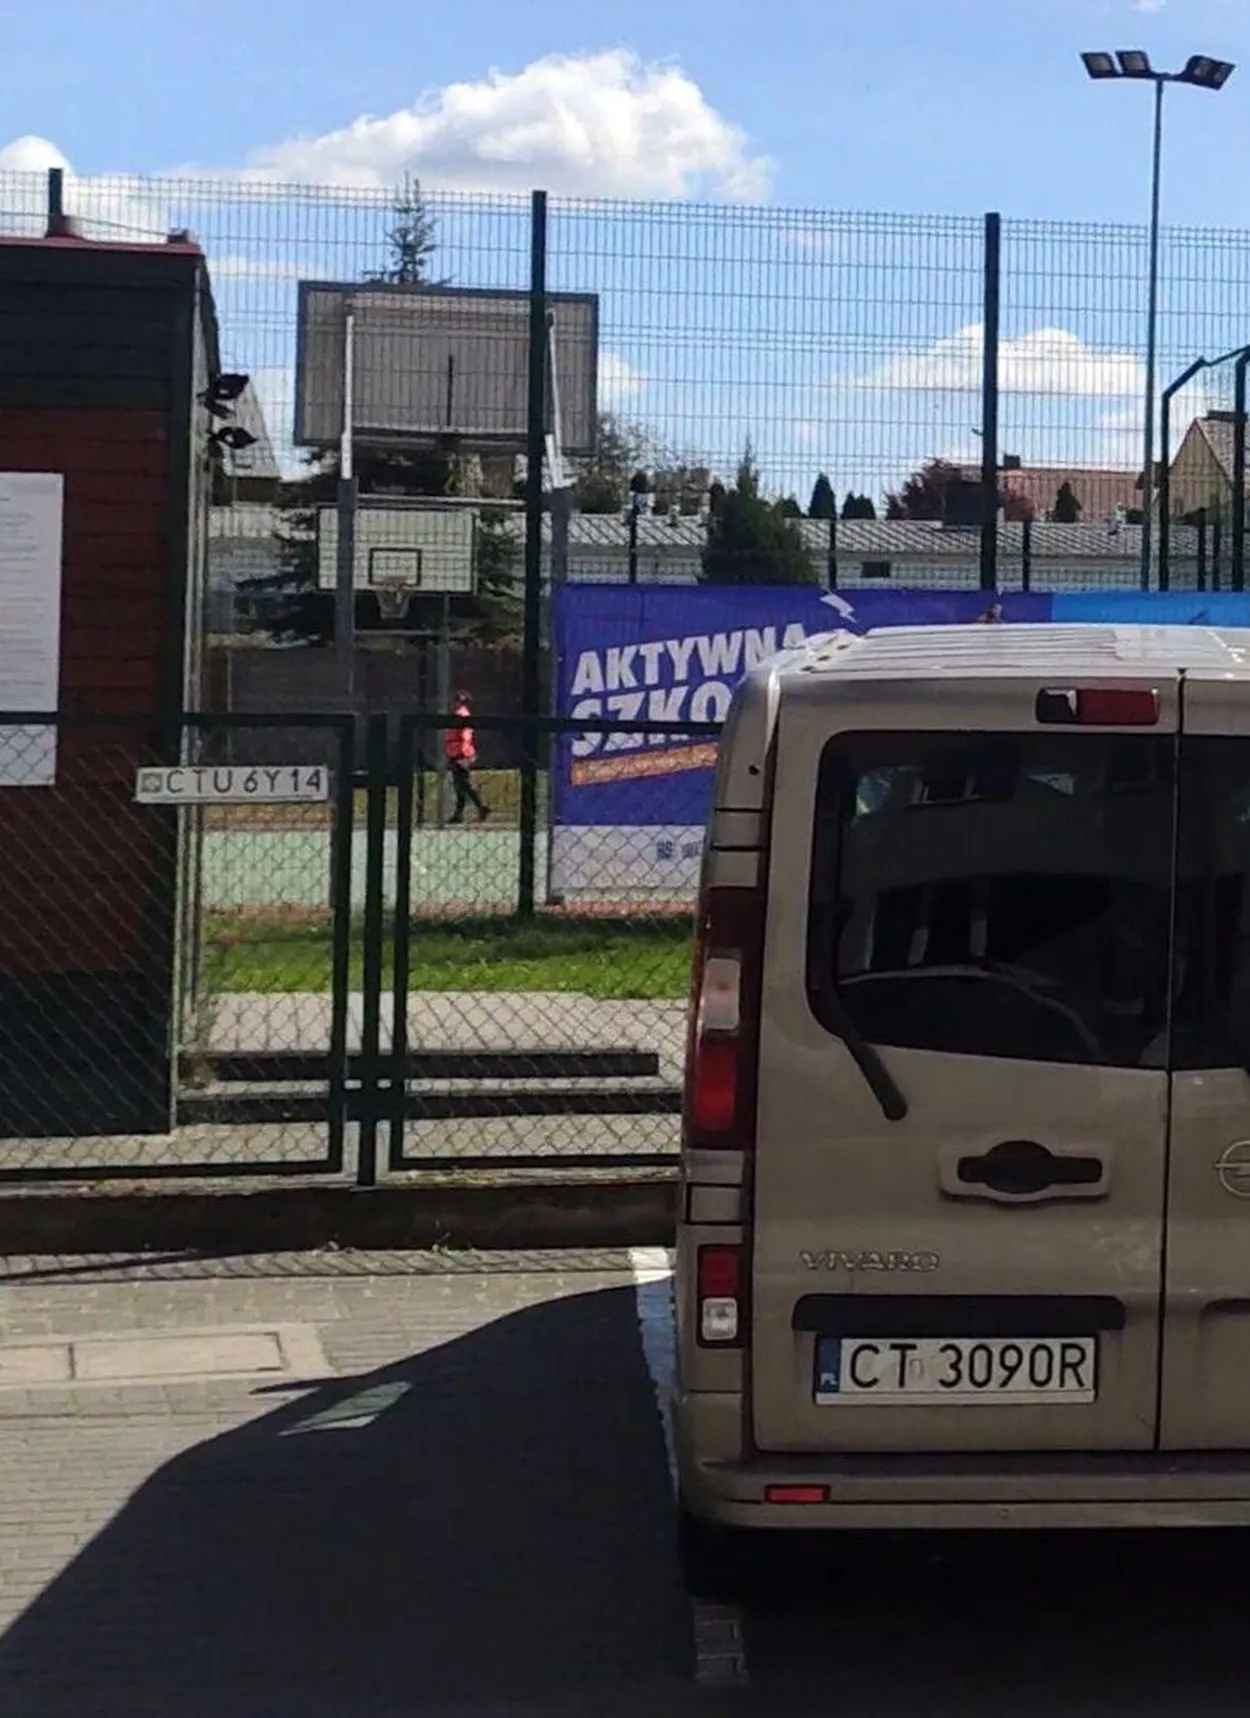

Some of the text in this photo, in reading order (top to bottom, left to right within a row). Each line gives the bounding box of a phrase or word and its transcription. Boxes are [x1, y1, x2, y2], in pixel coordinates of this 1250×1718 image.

[571, 622, 806, 696] AKTYWNA
[166, 768, 321, 793] CTU 6Y14
[799, 1249, 941, 1272] VIVARO
[849, 1343, 1087, 1389] CT 3090R
